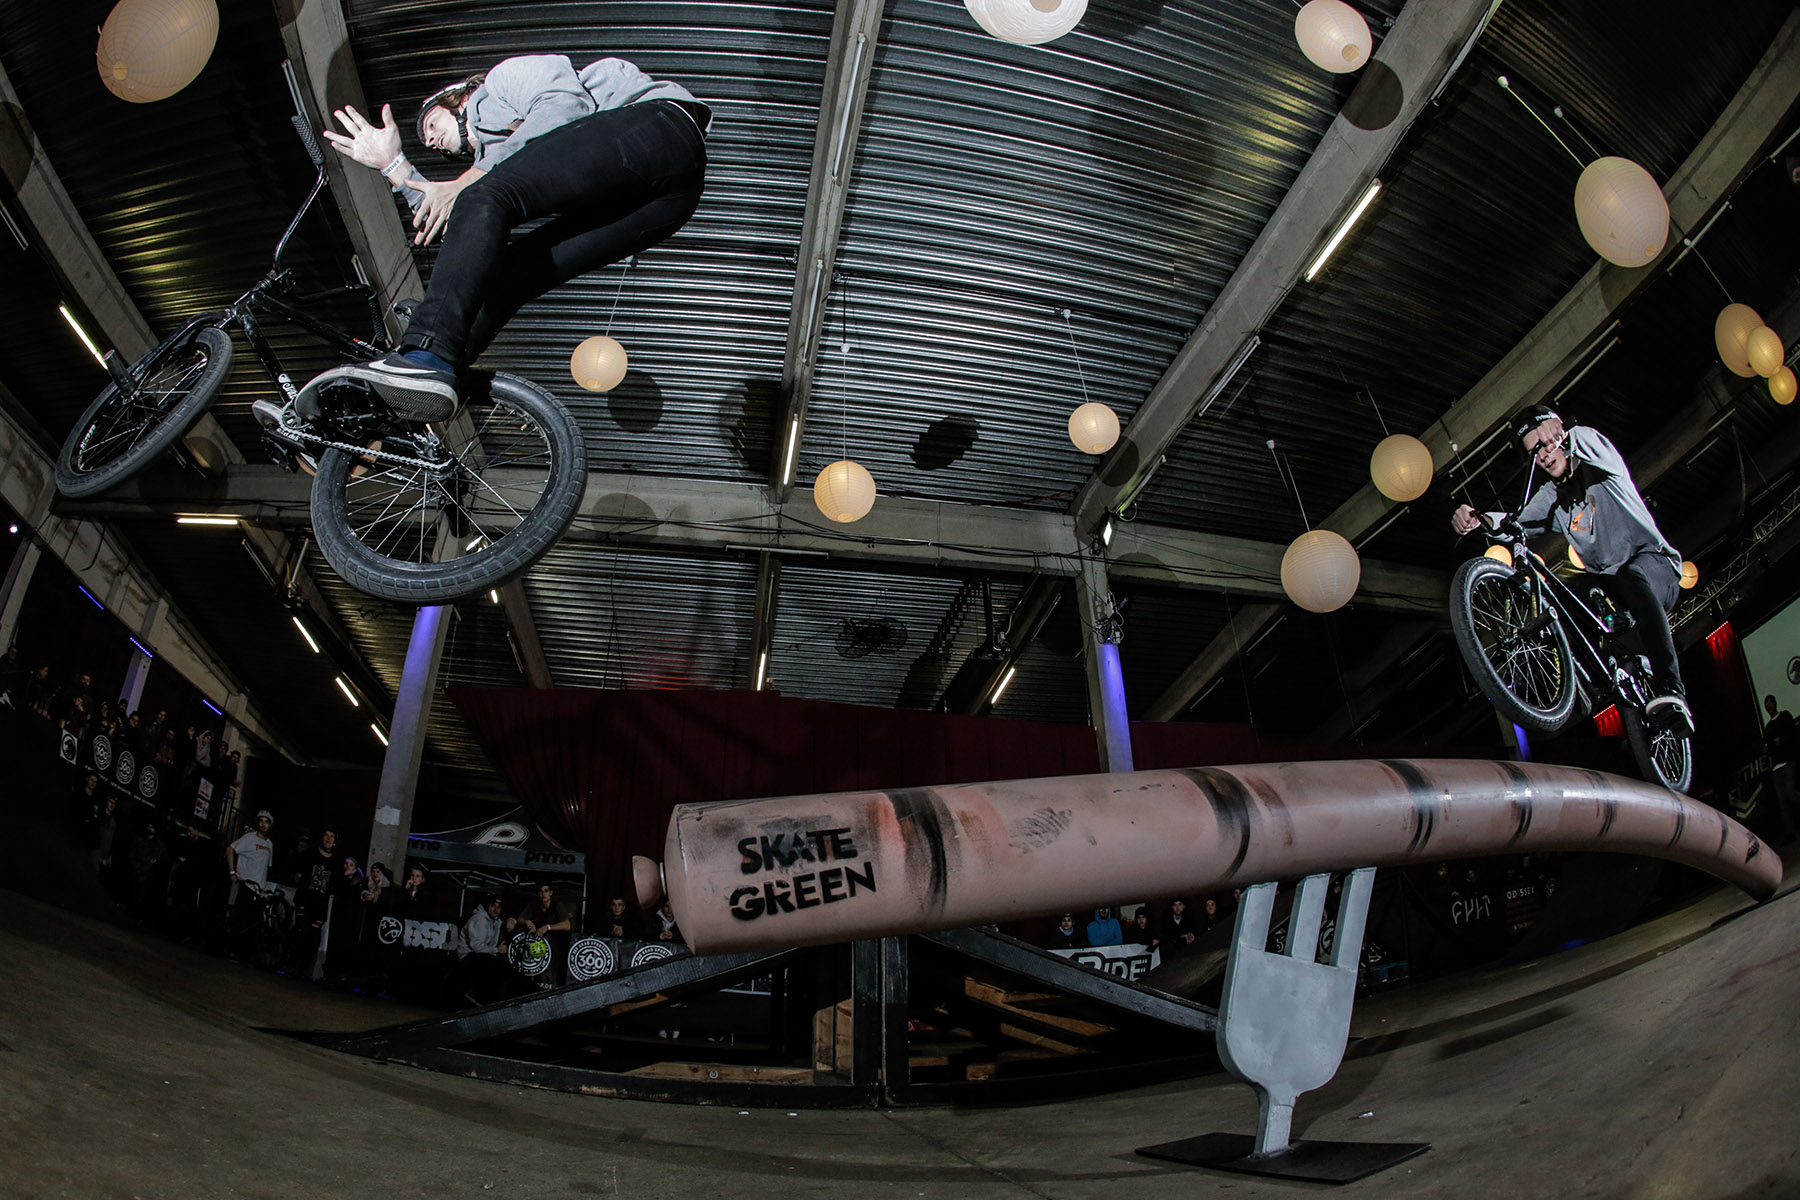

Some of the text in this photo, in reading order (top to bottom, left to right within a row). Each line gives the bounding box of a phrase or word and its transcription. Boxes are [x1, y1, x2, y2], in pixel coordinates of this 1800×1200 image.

[525, 850, 576, 865] primo
[737, 827, 858, 875] SKATE
[728, 861, 877, 921] GREEN
[577, 953, 604, 970] 360
